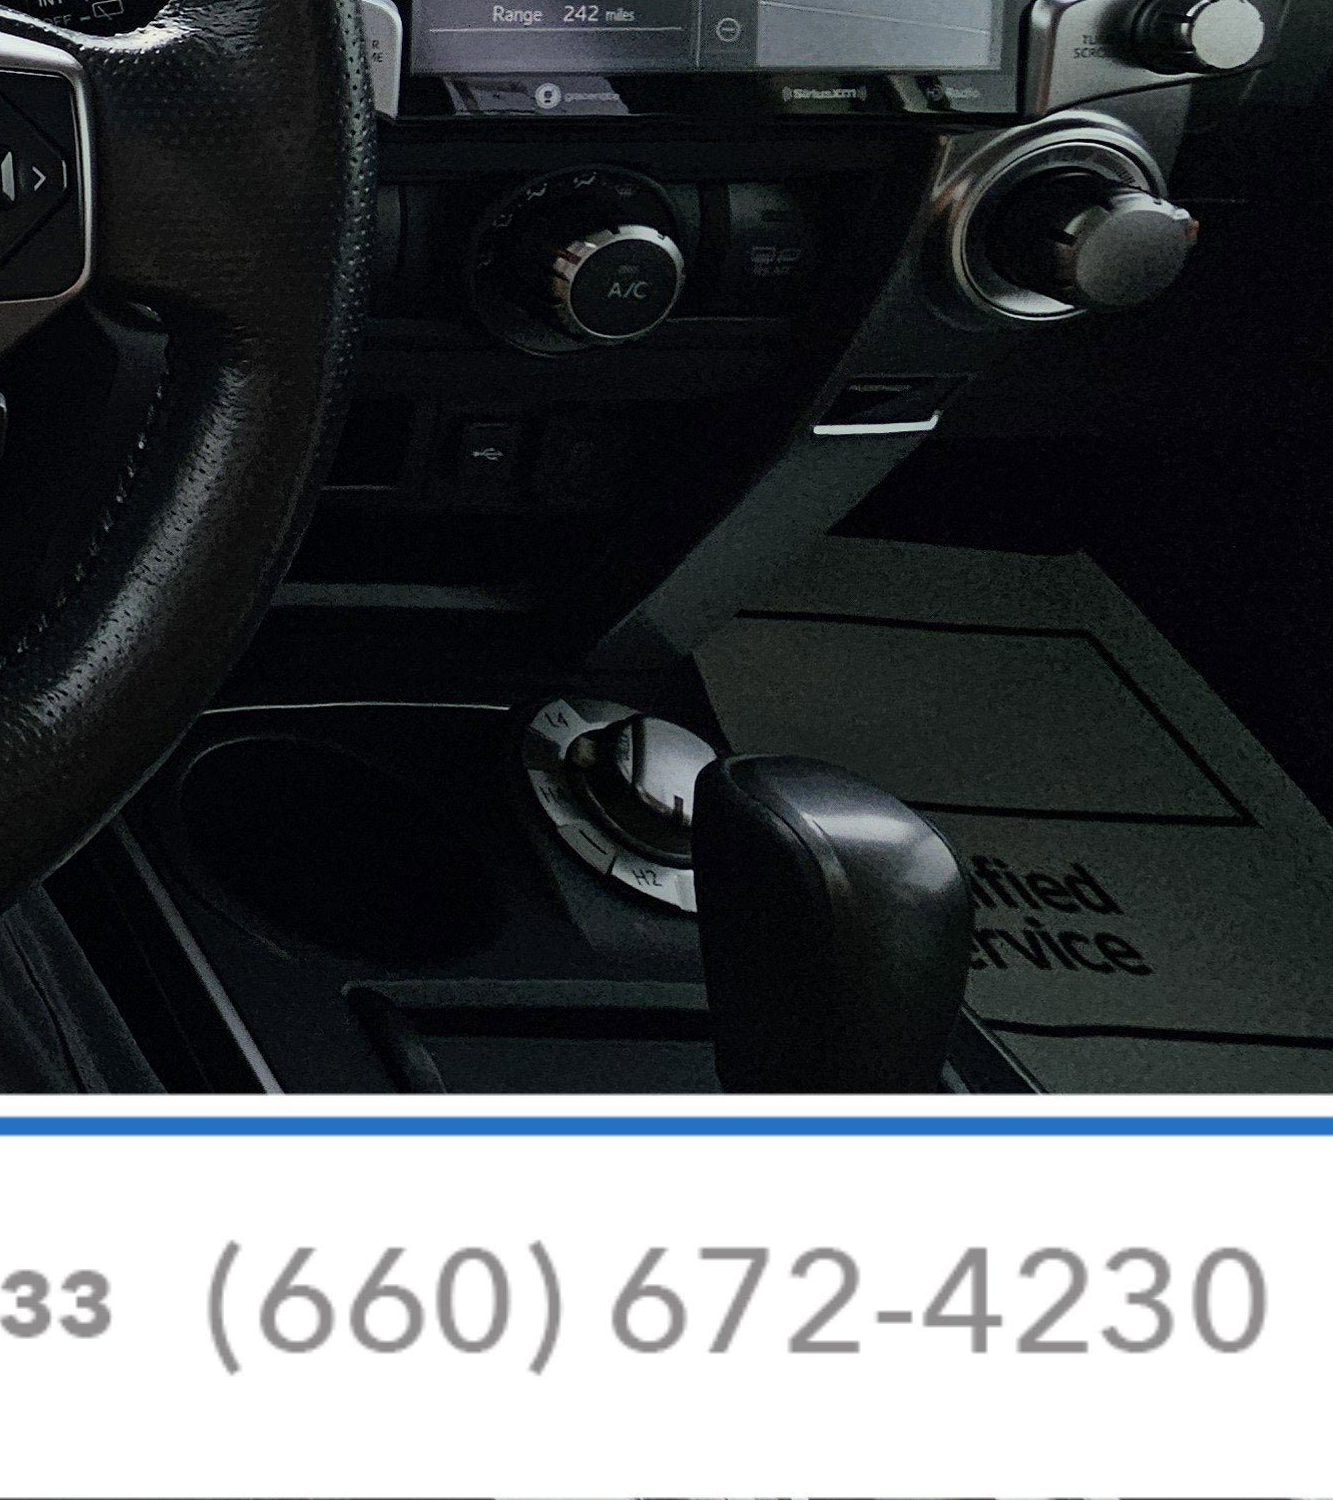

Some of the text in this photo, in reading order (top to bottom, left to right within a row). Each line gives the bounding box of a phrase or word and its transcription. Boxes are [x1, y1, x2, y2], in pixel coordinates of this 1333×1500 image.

[492, 5, 635, 27] Range 242 miles
[607, 279, 648, 300] A/C
[632, 869, 663, 889] H2
